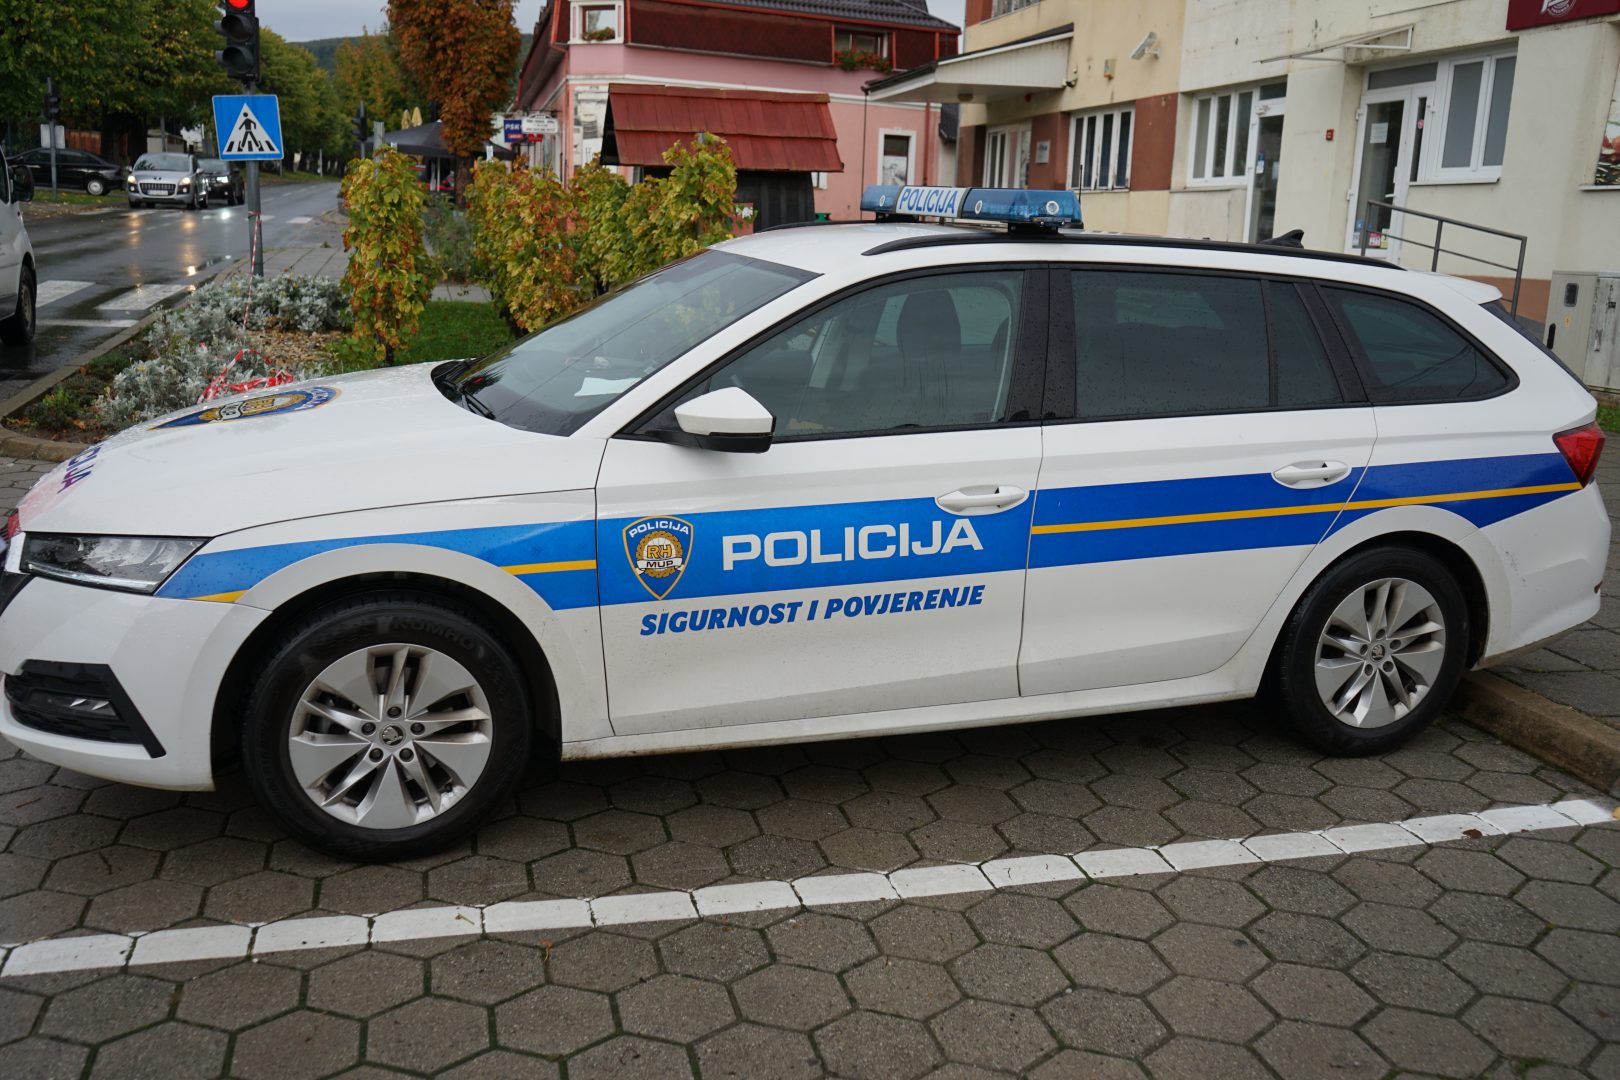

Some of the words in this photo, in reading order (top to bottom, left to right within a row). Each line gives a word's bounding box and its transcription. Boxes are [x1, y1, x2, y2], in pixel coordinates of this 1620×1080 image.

[899, 189, 958, 214] POLICIJA
[628, 520, 690, 538] POLICIJA
[646, 544, 673, 559] RH
[722, 518, 984, 571] POLICIJA
[646, 560, 674, 568] MUP
[640, 601, 803, 636] SIGURNOST
[806, 599, 819, 620] I
[824, 585, 986, 619] POVJERENJE
